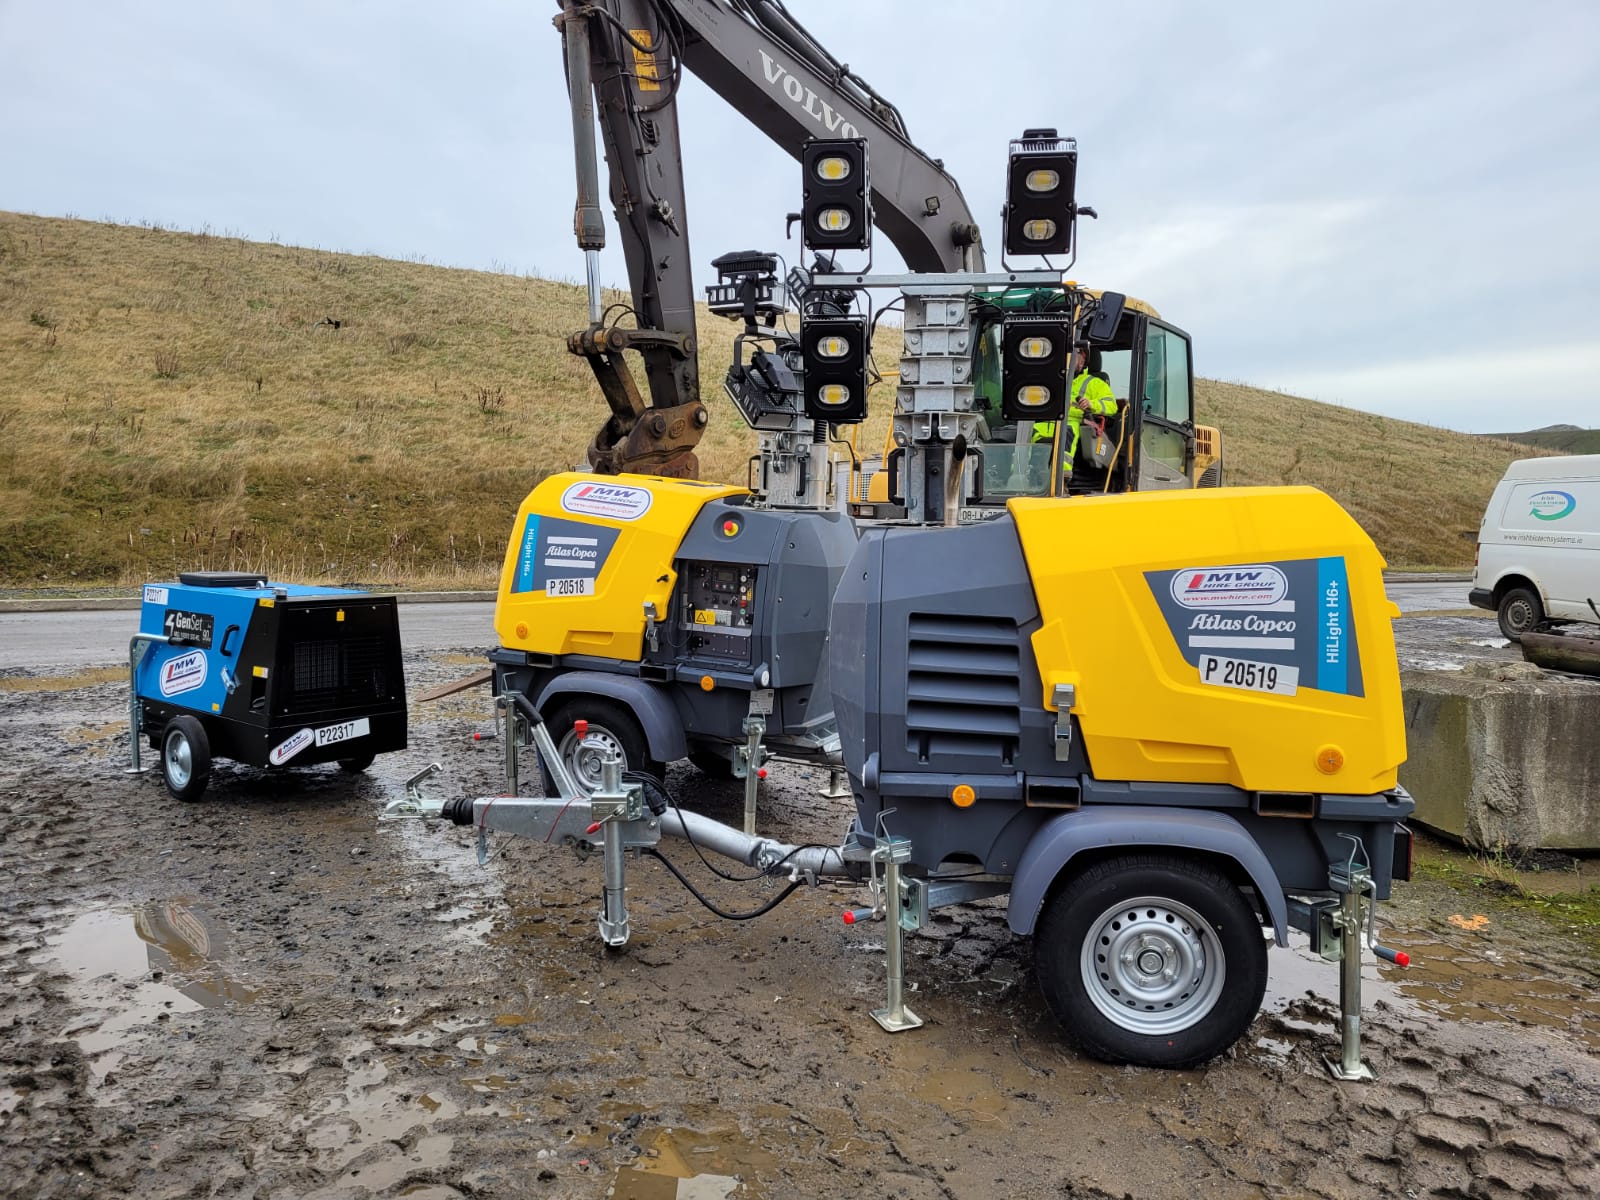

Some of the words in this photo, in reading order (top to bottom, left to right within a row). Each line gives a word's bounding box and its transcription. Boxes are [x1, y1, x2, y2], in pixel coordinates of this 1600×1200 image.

[759, 49, 860, 139] VOLVO
[525, 528, 535, 558] HiLight
[545, 545, 572, 557] Atlas
[572, 547, 598, 560] Copco
[550, 580, 556, 595] P
[559, 579, 585, 594] 20518
[1207, 572, 1263, 582] MW
[1183, 594, 1273, 602] www.mwhire.com
[1326, 580, 1339, 607] H6+
[176, 612, 203, 631] GenSet
[1187, 613, 1242, 630] Atlas
[1243, 615, 1297, 635] Copco
[1326, 611, 1342, 663] HiLight
[1205, 657, 1218, 681] P
[1223, 660, 1278, 690] 20519
[319, 723, 355, 744] P22317
